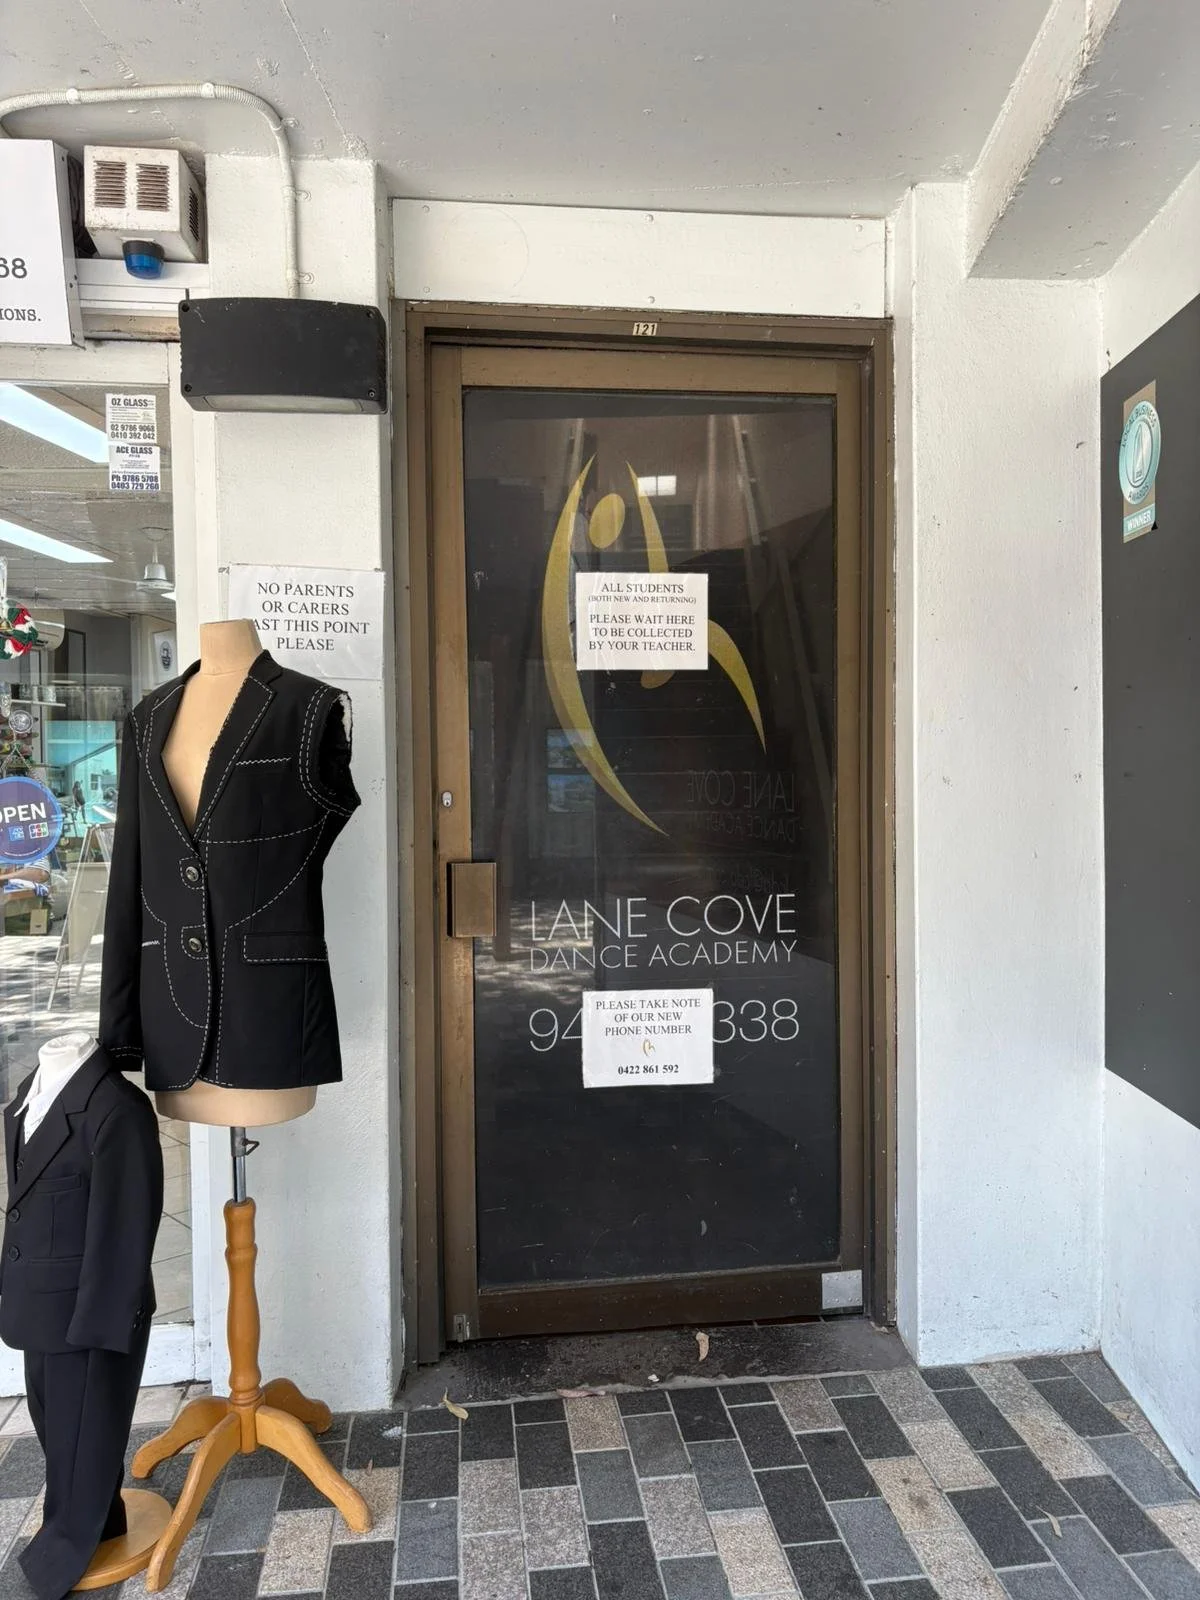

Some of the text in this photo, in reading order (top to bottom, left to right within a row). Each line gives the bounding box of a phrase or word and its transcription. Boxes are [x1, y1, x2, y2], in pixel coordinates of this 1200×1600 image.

[636, 324, 656, 336] 121
[112, 398, 121, 406] OZ
[124, 399, 148, 407] GLASS
[116, 446, 152, 454] ACE GLASS
[1128, 510, 1152, 532] WINNER
[258, 583, 354, 598] NO PARENTS
[601, 583, 684, 593] ALL STUDENTS
[651, 596, 696, 604] RETURNING)
[262, 601, 349, 615] OR CARERS
[590, 614, 695, 624] PLEASE WAIT HERE
[254, 619, 370, 634] AST THIS POINT
[593, 628, 693, 638] TO BE COLLECTED
[277, 637, 334, 650] PLEASE
[589, 641, 695, 651] BY YOUR TEACHER.
[0, 802, 46, 824] PEN
[532, 894, 796, 941] LANE COVE
[530, 940, 797, 972] DANCE ACADEMY
[596, 998, 701, 1010] PLEASE TAKE NOTE
[614, 1012, 683, 1022] OF OUR NEW
[712, 998, 799, 1043] 338
[605, 1025, 692, 1036] PHONE NUMBER
[618, 1064, 679, 1075] 0422 861 592
